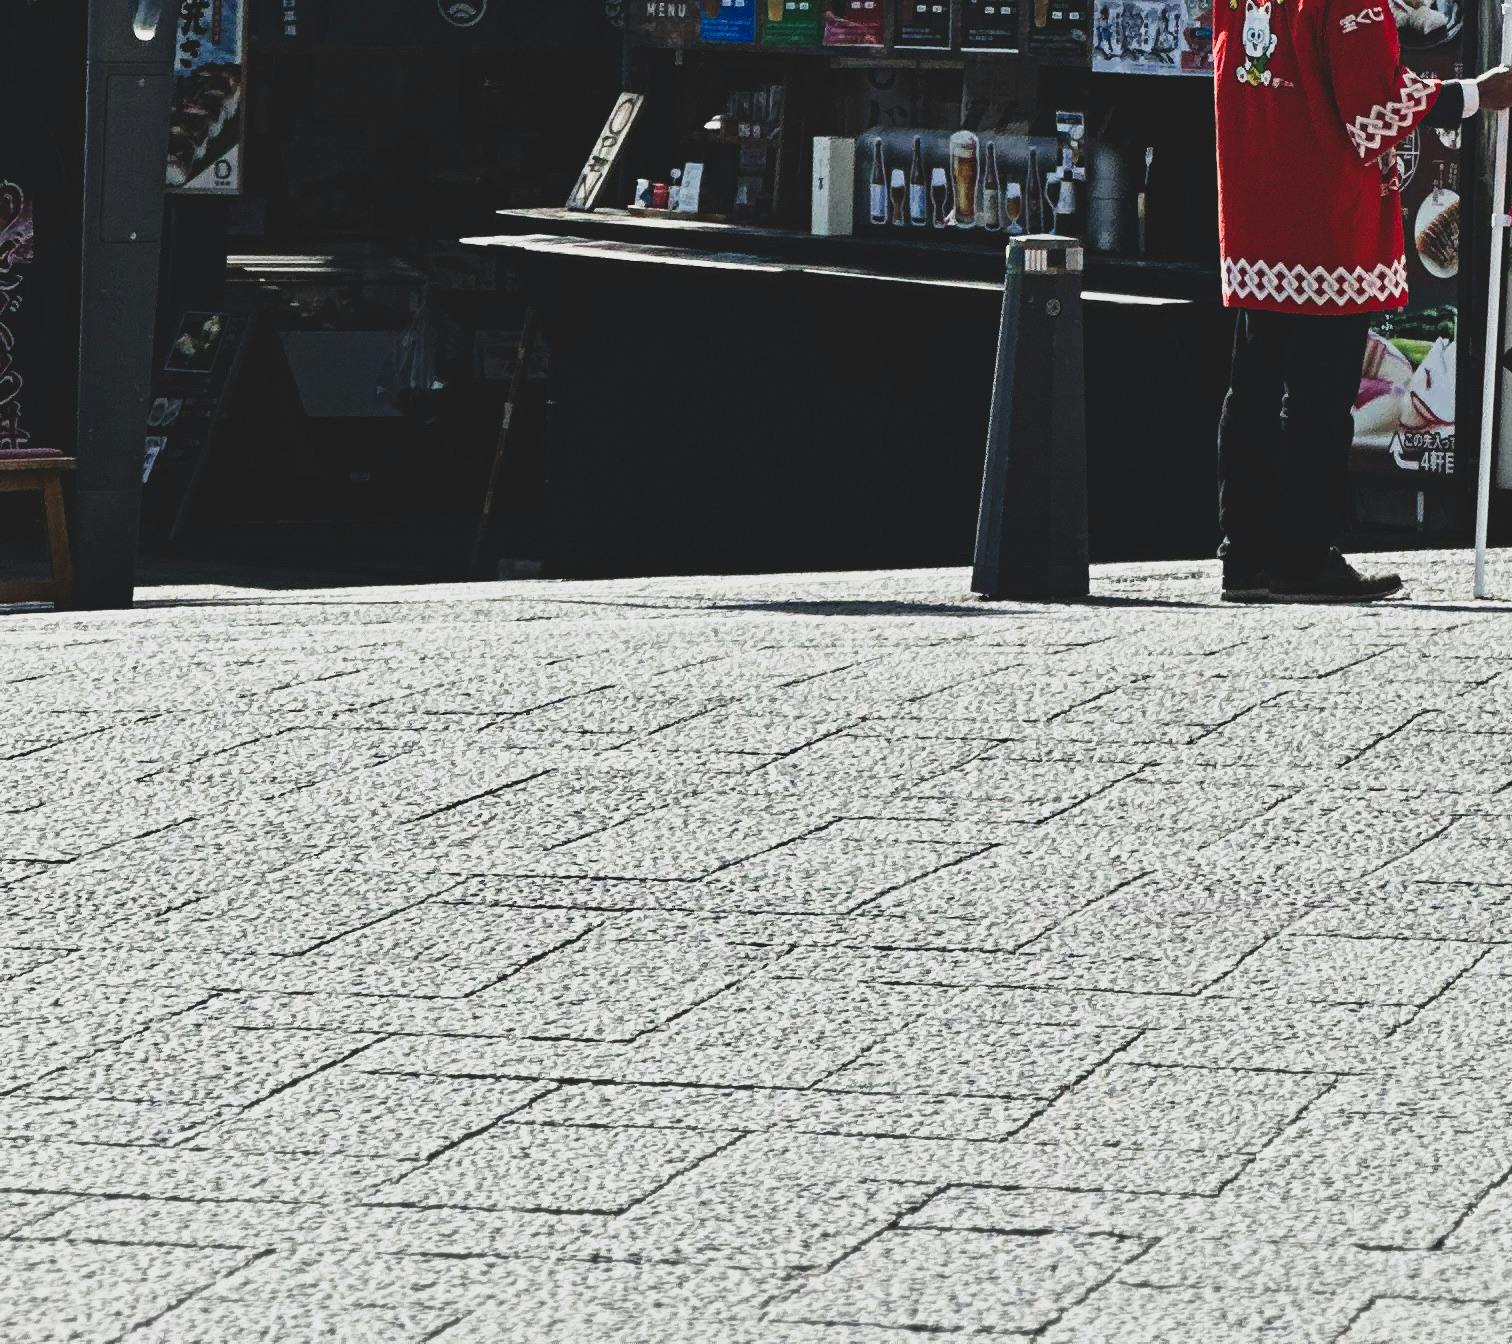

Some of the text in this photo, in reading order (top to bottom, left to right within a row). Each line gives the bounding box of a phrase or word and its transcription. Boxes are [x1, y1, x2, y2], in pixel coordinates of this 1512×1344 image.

[645, 1, 688, 18] MENU
[1339, 6, 1385, 34] 宝くじ
[568, 97, 635, 208] OPEN
